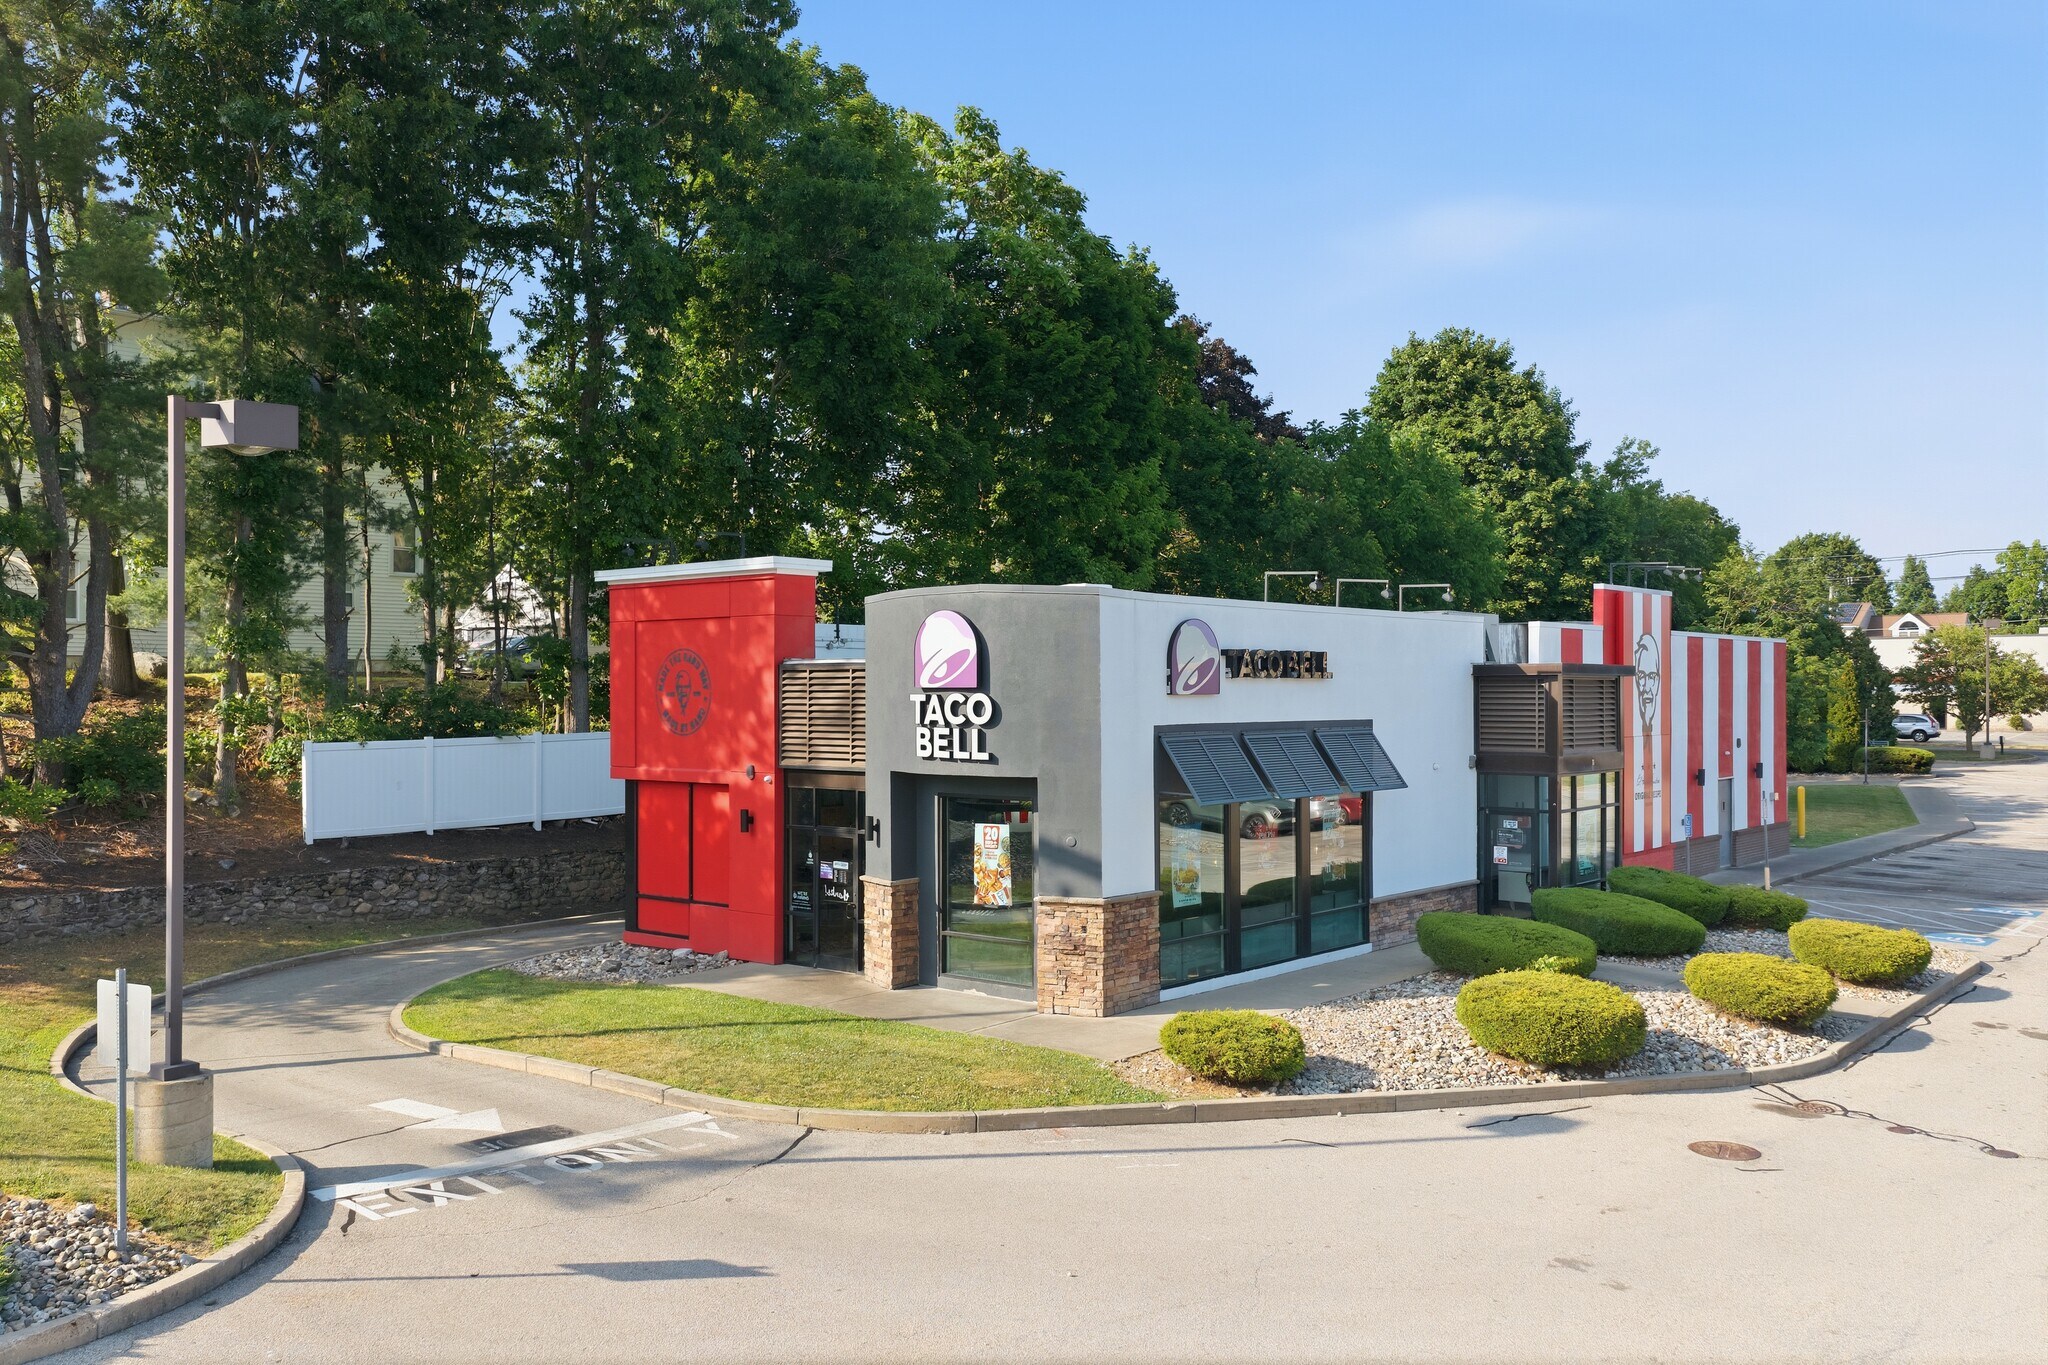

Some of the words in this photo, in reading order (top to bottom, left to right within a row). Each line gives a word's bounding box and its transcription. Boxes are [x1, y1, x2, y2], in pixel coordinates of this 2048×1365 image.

[1221, 649, 1283, 678] TACO
[1284, 650, 1333, 679] BELL
[909, 692, 993, 725] TACO
[916, 726, 989, 760] BELL
[985, 827, 999, 841] 20
[337, 1164, 545, 1221] EXIT
[543, 1122, 739, 1174] ONLY
